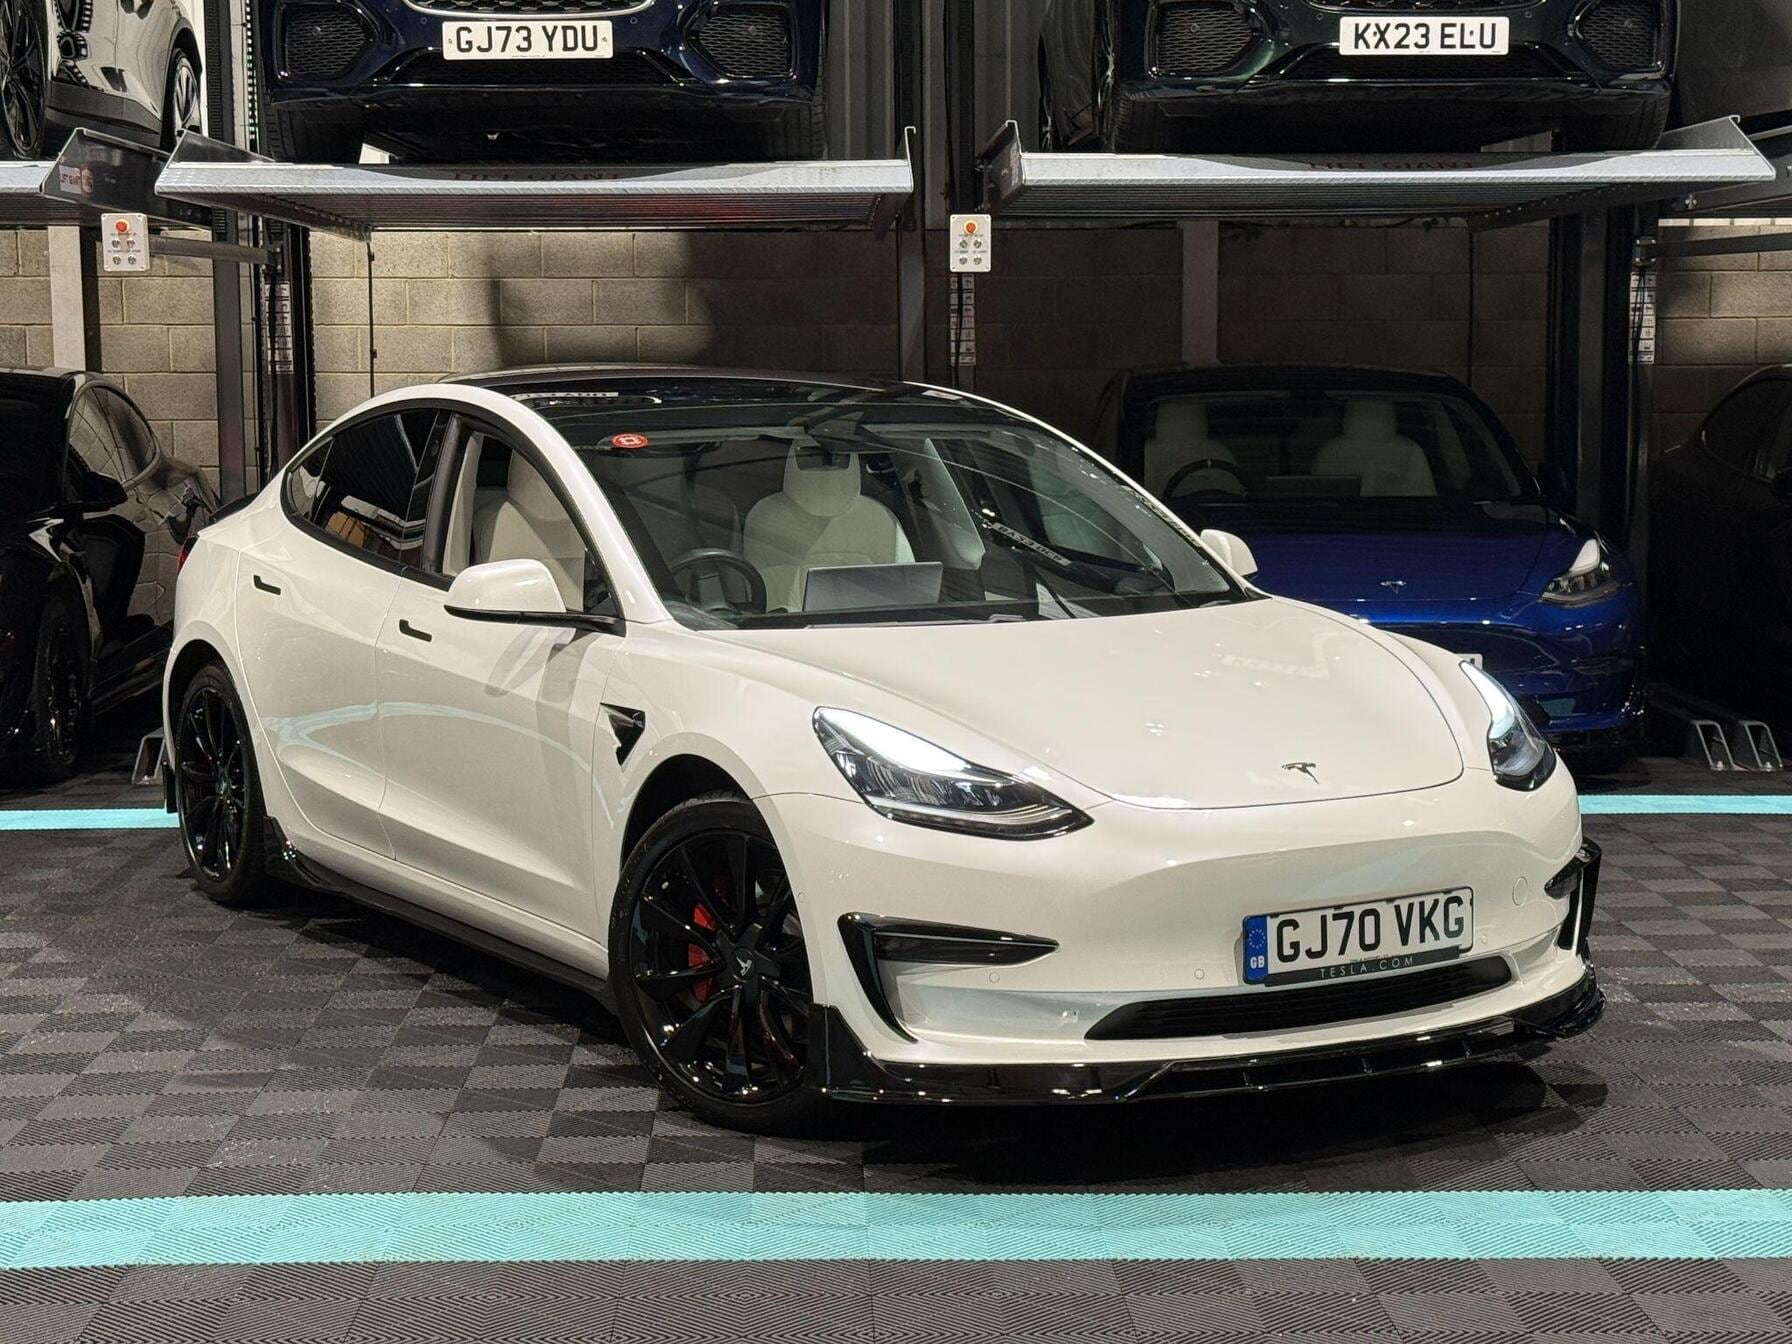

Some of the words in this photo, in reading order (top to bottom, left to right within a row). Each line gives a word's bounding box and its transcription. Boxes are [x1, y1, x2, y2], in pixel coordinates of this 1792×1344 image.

[456, 25, 533, 53] GJ73
[542, 25, 598, 52] YDU
[1354, 22, 1430, 49] KX23
[1440, 22, 1496, 49] ELU
[1276, 907, 1381, 963] GJ70
[1394, 895, 1465, 947] VKG
[1250, 955, 1265, 969] GB
[1320, 955, 1414, 979] TESLA.COM
